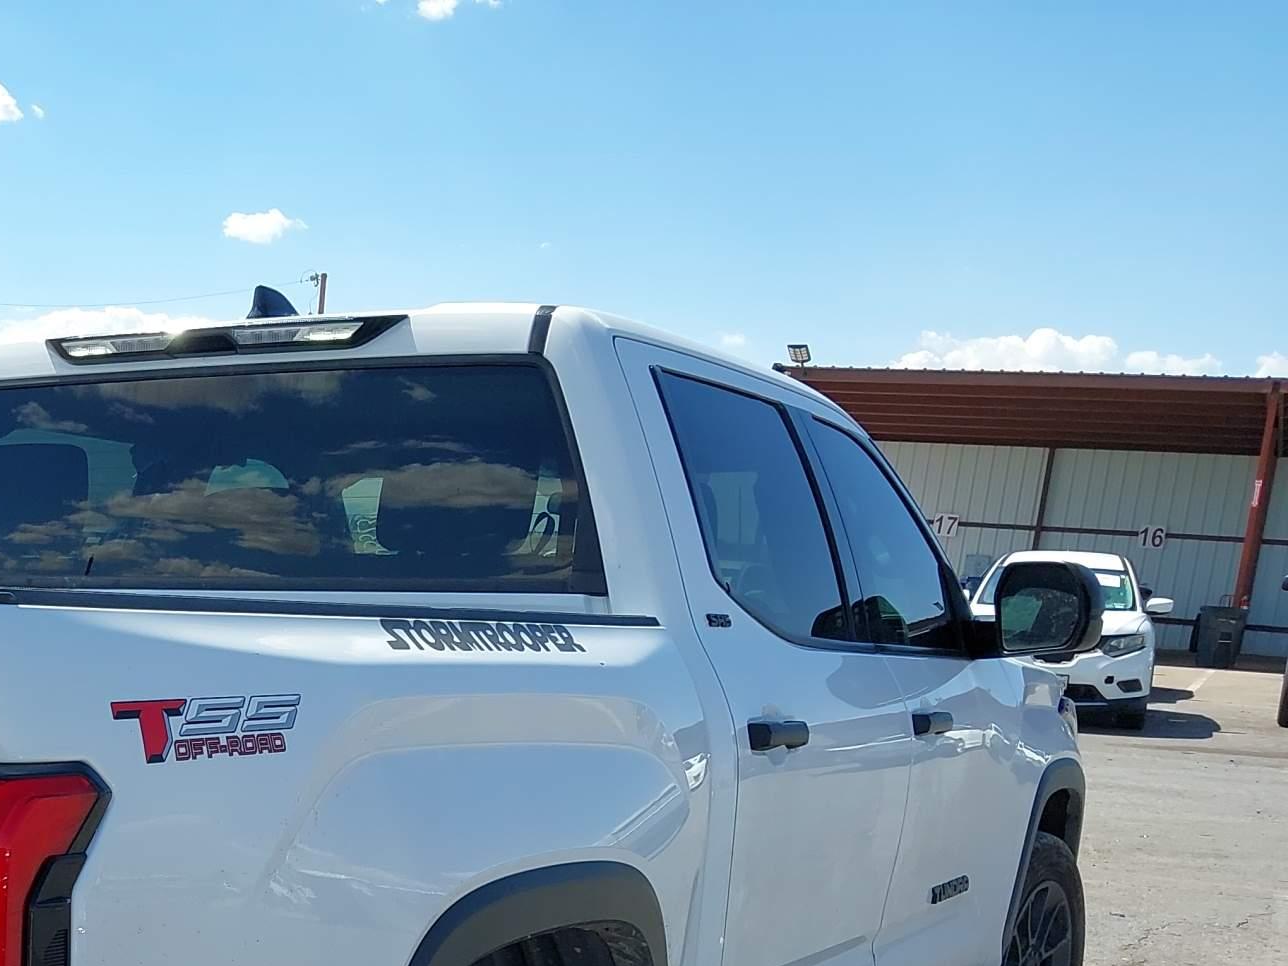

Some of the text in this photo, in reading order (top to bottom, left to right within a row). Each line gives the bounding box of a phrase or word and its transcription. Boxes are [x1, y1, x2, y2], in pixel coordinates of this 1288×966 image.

[936, 515, 958, 535] 17
[1140, 527, 1164, 547] 16
[380, 618, 587, 653] STORMTROOPER
[174, 732, 286, 762] OFF-ROAD
